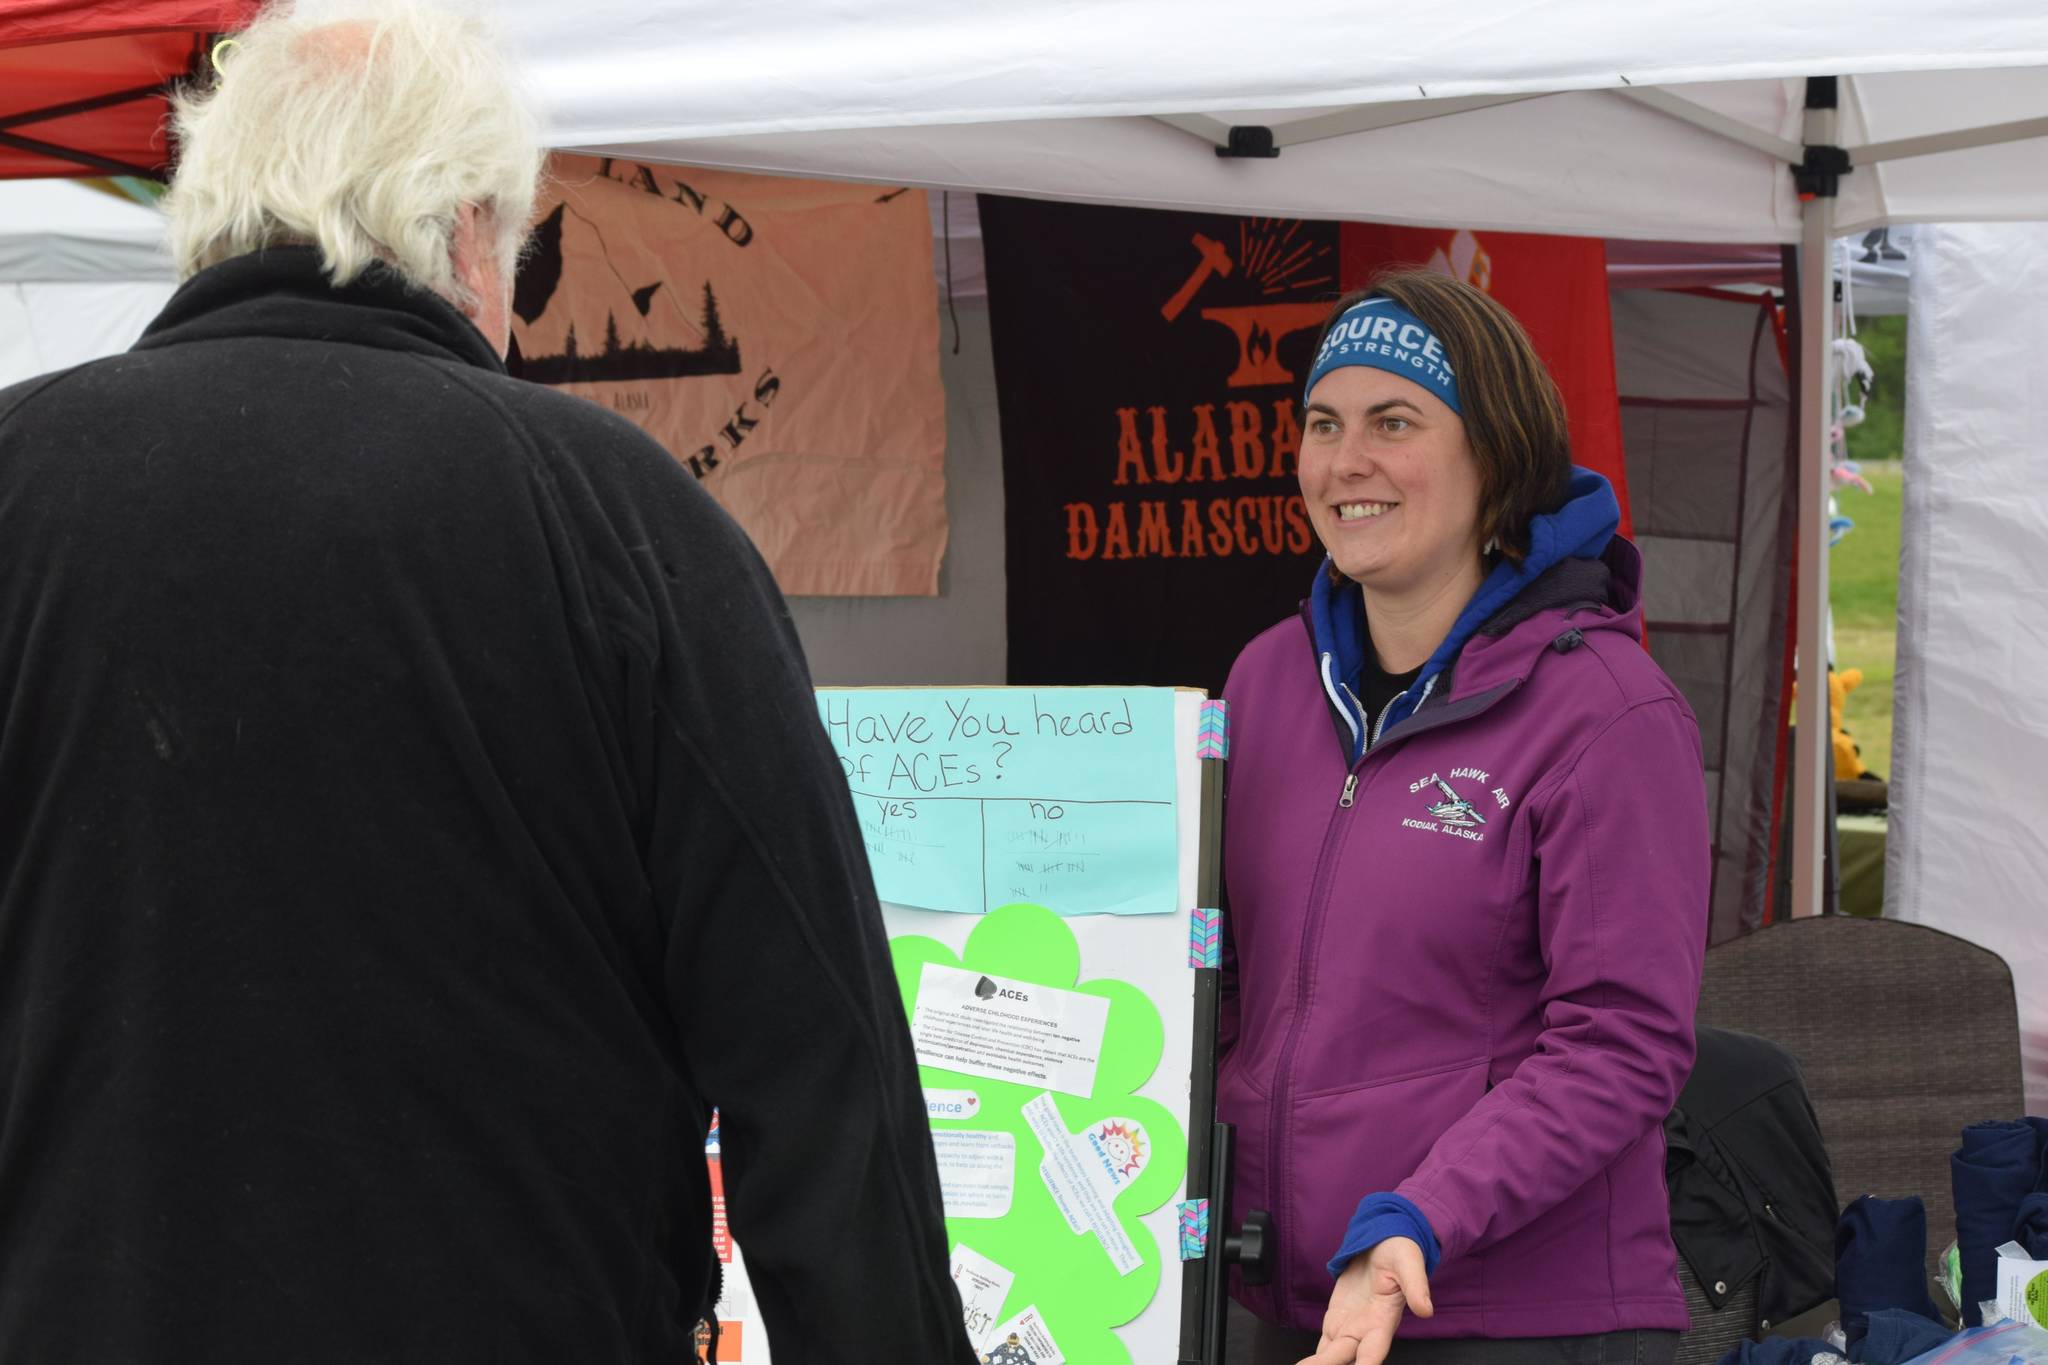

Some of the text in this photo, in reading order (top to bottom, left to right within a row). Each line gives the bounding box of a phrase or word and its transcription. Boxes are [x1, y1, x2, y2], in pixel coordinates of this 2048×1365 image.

[1339, 341, 1450, 386] STRENGTH
[1063, 496, 1312, 560] DAMASCUS
[827, 694, 1133, 747] Have You heard
[1409, 768, 1511, 809] SEA HAWK AIR
[877, 799, 1064, 824] yes no
[1441, 824, 1485, 841] ALASKA
[998, 988, 1029, 1003] ACEs
[961, 1004, 1058, 1028] ADVERSE CHILDHOOD EXPERIENCES
[955, 1056, 968, 1064] help
[968, 1058, 986, 1068] buffer
[987, 1062, 1002, 1071] these
[1003, 1065, 1027, 1076] negative
[1086, 1132, 1123, 1186] Good News
